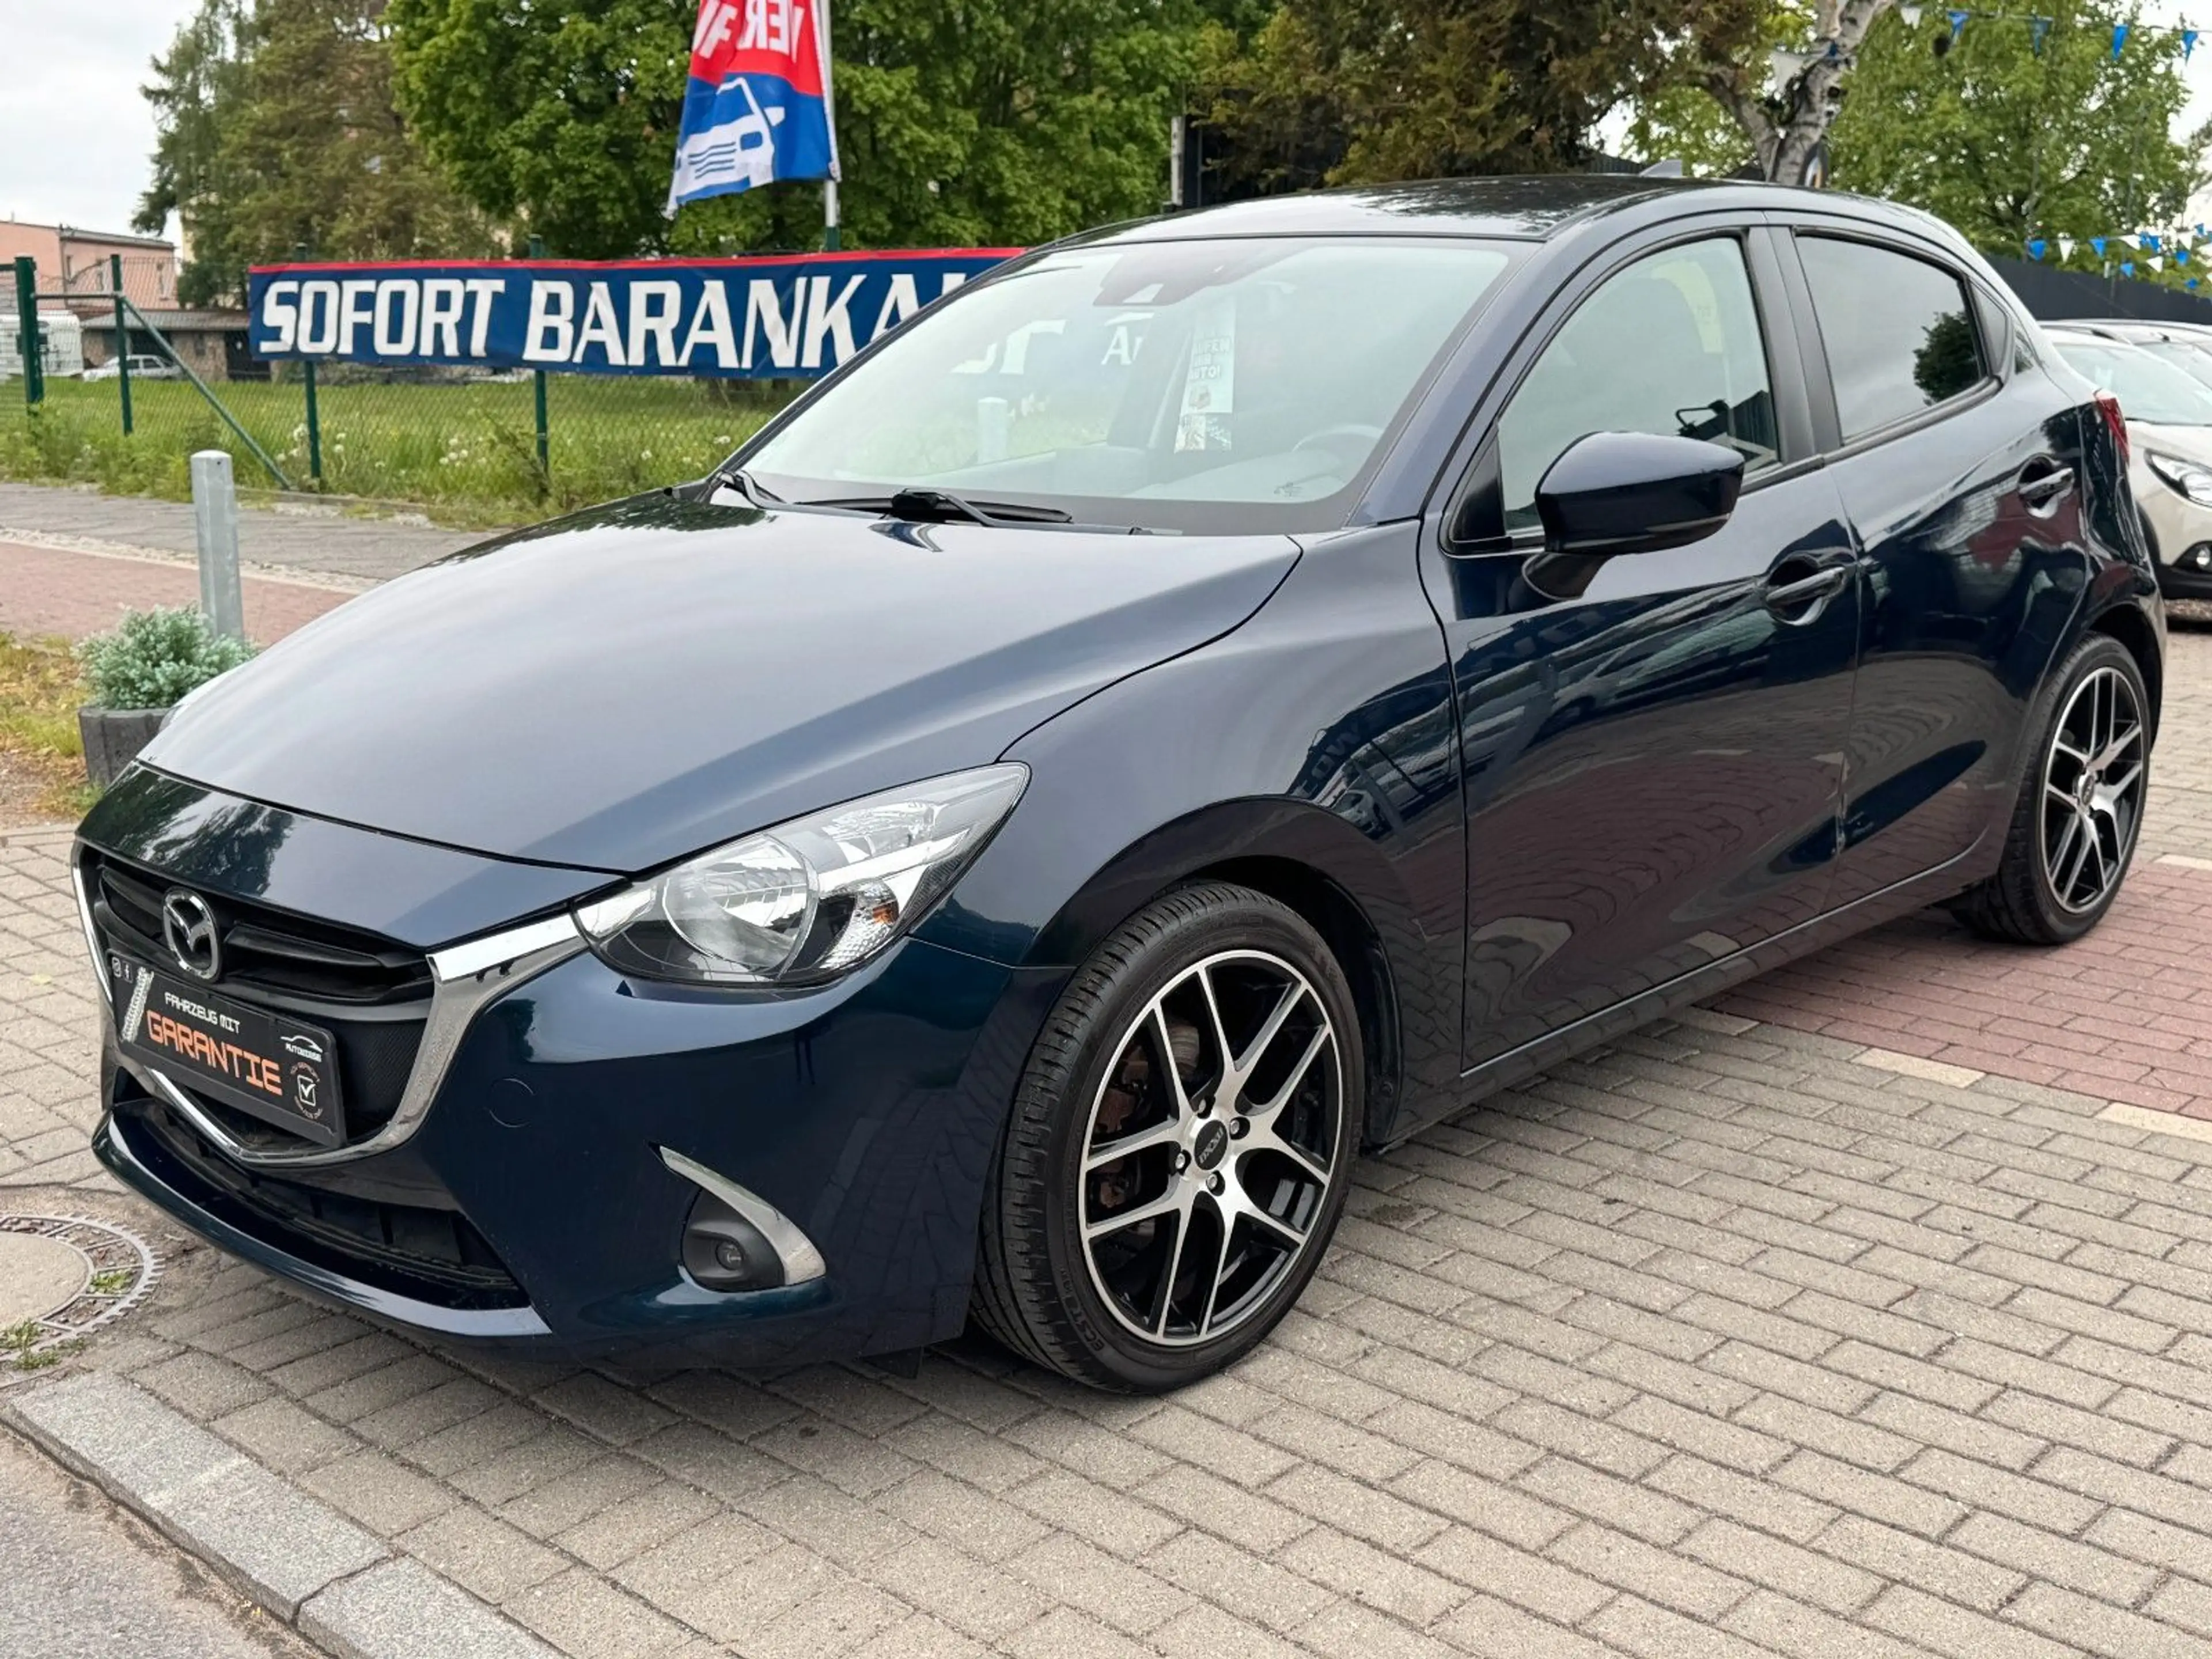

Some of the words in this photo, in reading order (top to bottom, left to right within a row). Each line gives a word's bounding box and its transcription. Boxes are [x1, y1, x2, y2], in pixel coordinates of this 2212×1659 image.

[260, 278, 505, 358] SOFORT
[164, 991, 218, 1025] FAHRZEUG
[219, 1014, 241, 1034] MIT
[146, 1010, 283, 1096] GARANTIE
